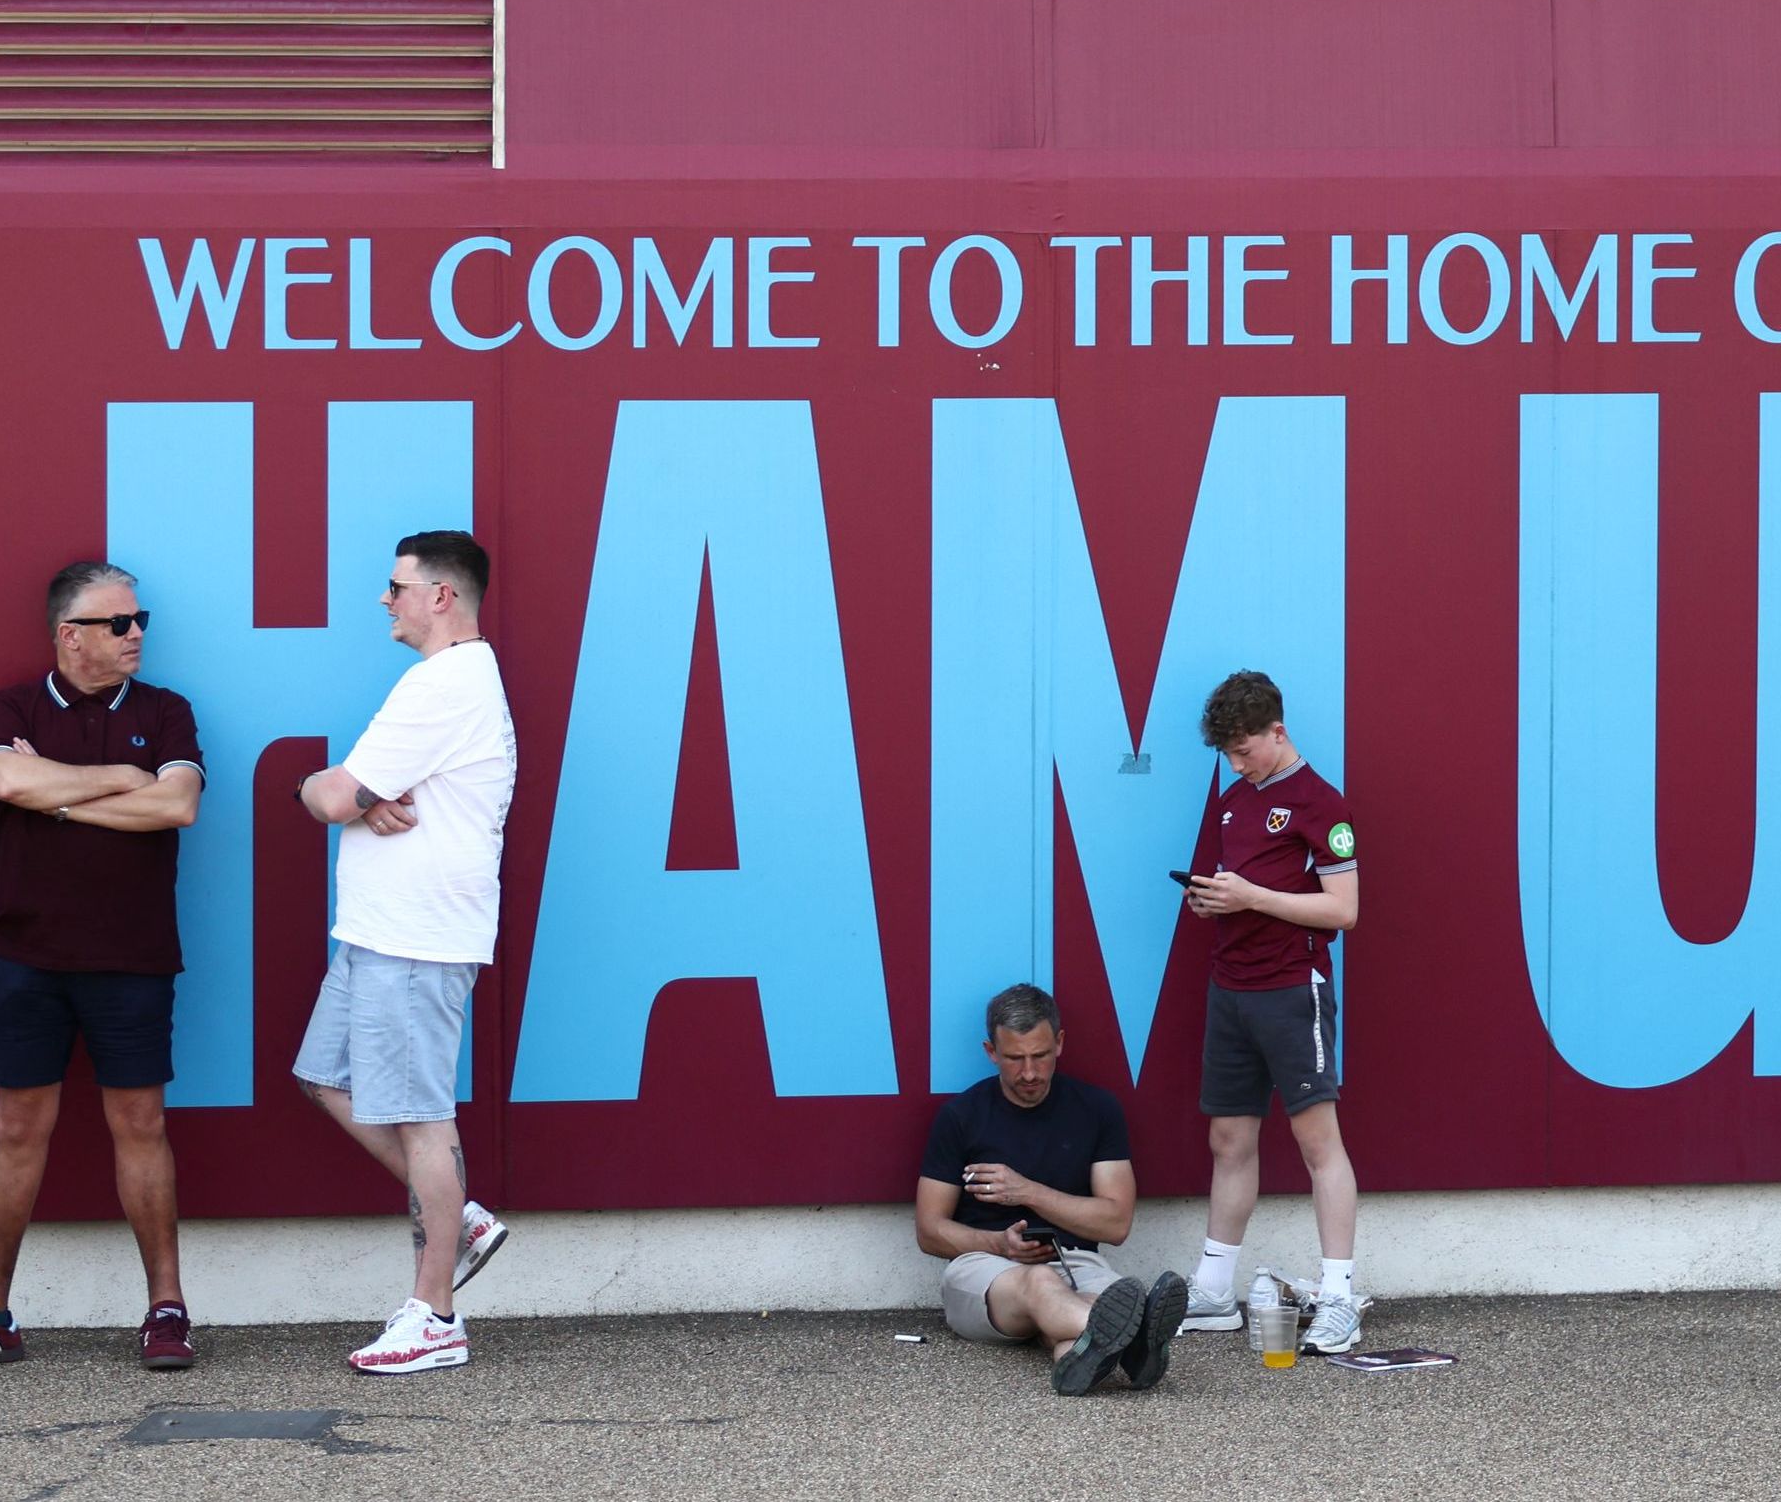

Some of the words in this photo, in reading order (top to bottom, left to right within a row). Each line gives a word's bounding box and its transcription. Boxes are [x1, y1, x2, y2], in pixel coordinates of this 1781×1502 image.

[138, 236, 820, 351] WELCOME
[852, 235, 1022, 348] TO
[1050, 235, 1294, 346] THE
[1331, 232, 1701, 345] HOME
[105, 396, 1347, 1108] HAM
